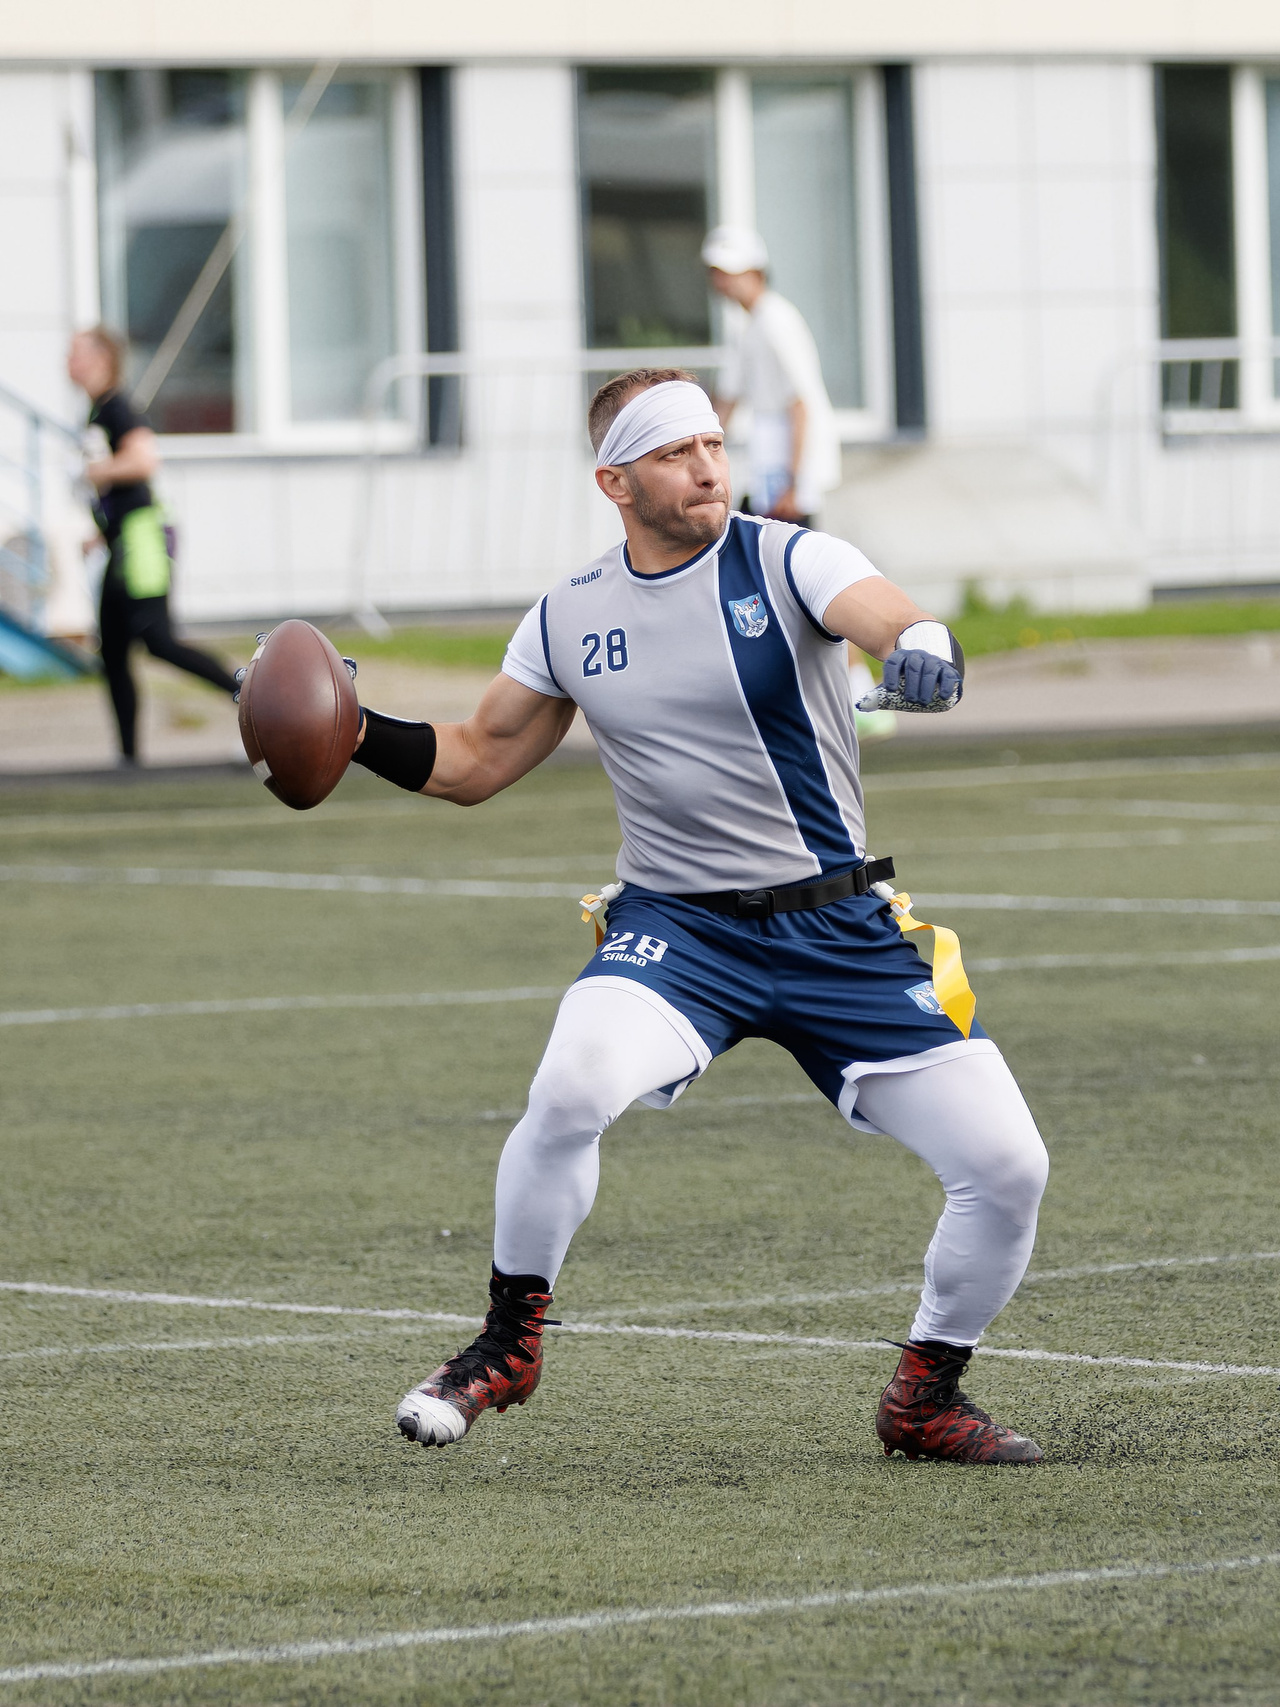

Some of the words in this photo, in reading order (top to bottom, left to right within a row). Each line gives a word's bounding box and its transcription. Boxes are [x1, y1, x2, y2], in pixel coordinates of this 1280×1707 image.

[570, 568, 602, 587] SQUAD
[581, 627, 630, 679] 28
[600, 931, 669, 962] 28
[601, 952, 648, 967] SQUAD
